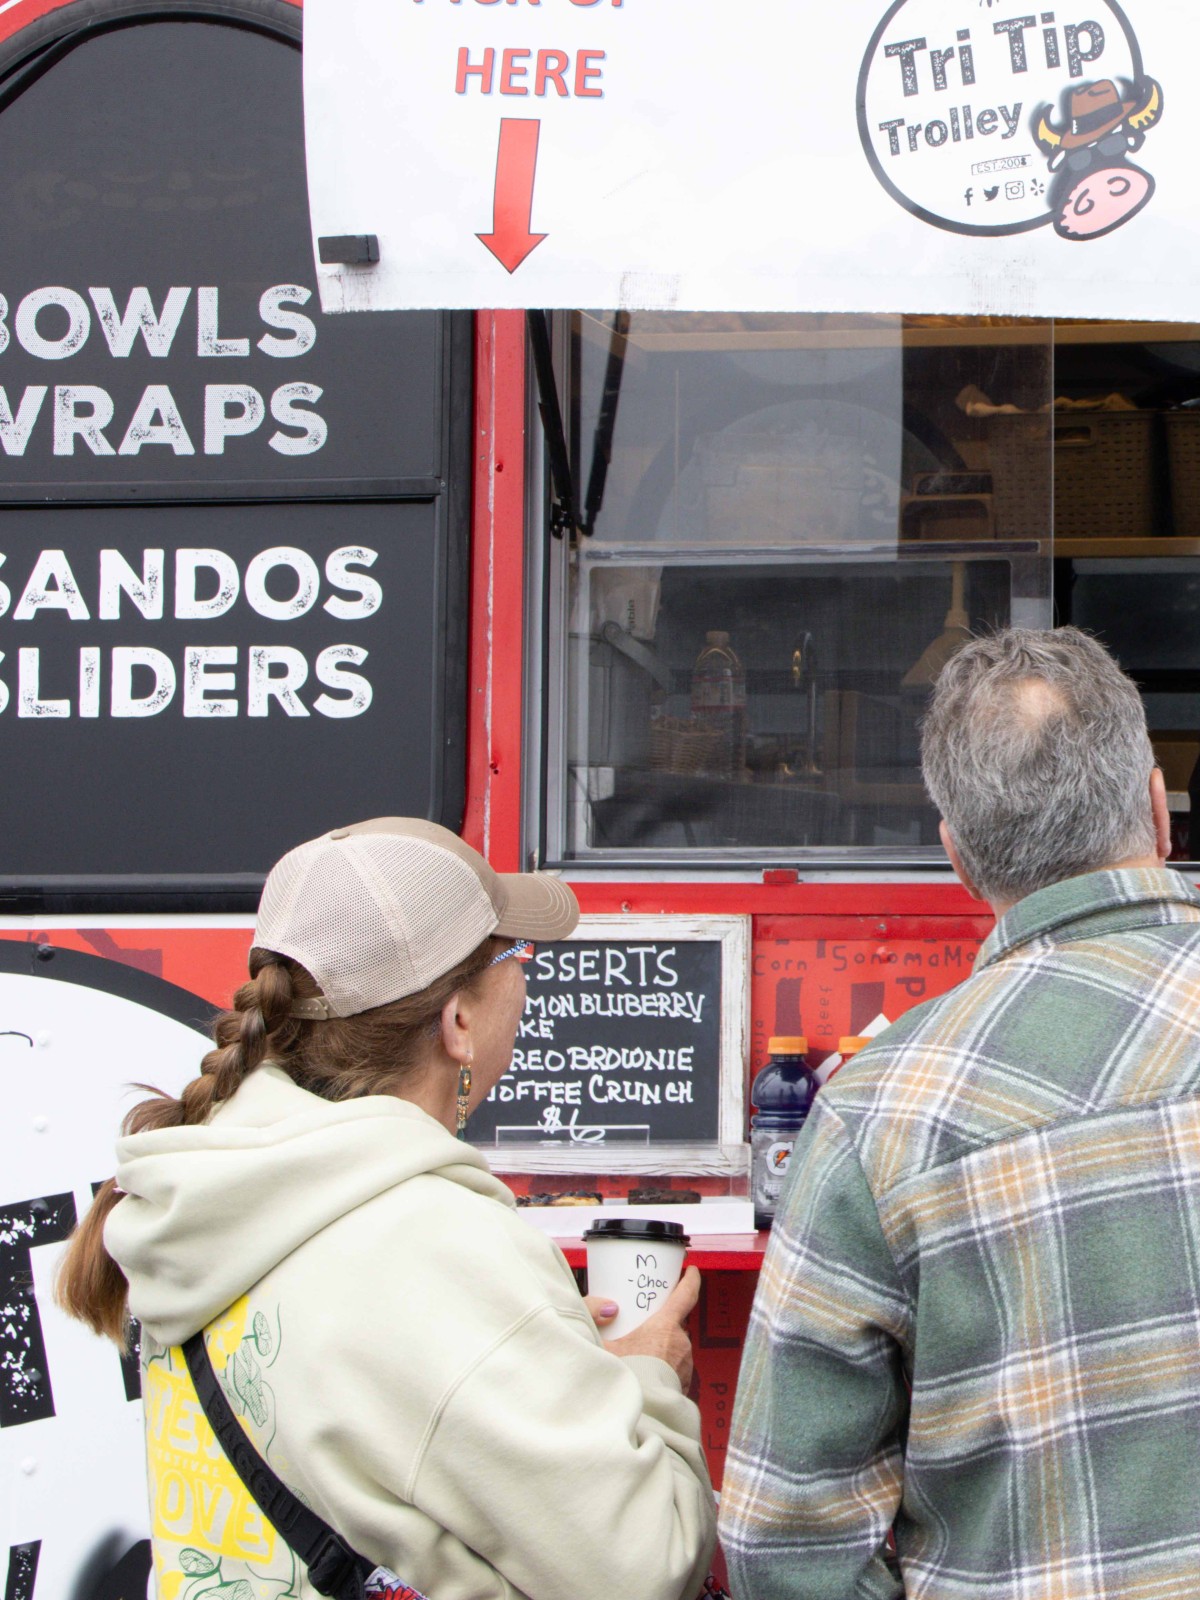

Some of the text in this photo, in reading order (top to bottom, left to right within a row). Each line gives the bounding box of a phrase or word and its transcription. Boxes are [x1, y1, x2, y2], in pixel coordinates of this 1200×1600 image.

[455, 46, 606, 98] HERE
[883, 11, 1106, 97] Tri Tip
[879, 102, 1023, 156] Trolley
[0, 284, 317, 360] OWLS
[0, 545, 383, 621] ANDOS
[0, 643, 373, 719] LIDERS
[525, 945, 679, 987] SSERTS
[752, 954, 808, 976] Corn
[515, 1018, 554, 1041] KE
[525, 991, 705, 1022] MON BLUBERRY
[818, 984, 833, 1036] Beef
[509, 1045, 694, 1072] REO BROWNIE
[754, 1019, 765, 1068] otija
[636, 1254, 657, 1269] M
[636, 1291, 657, 1311] CP
